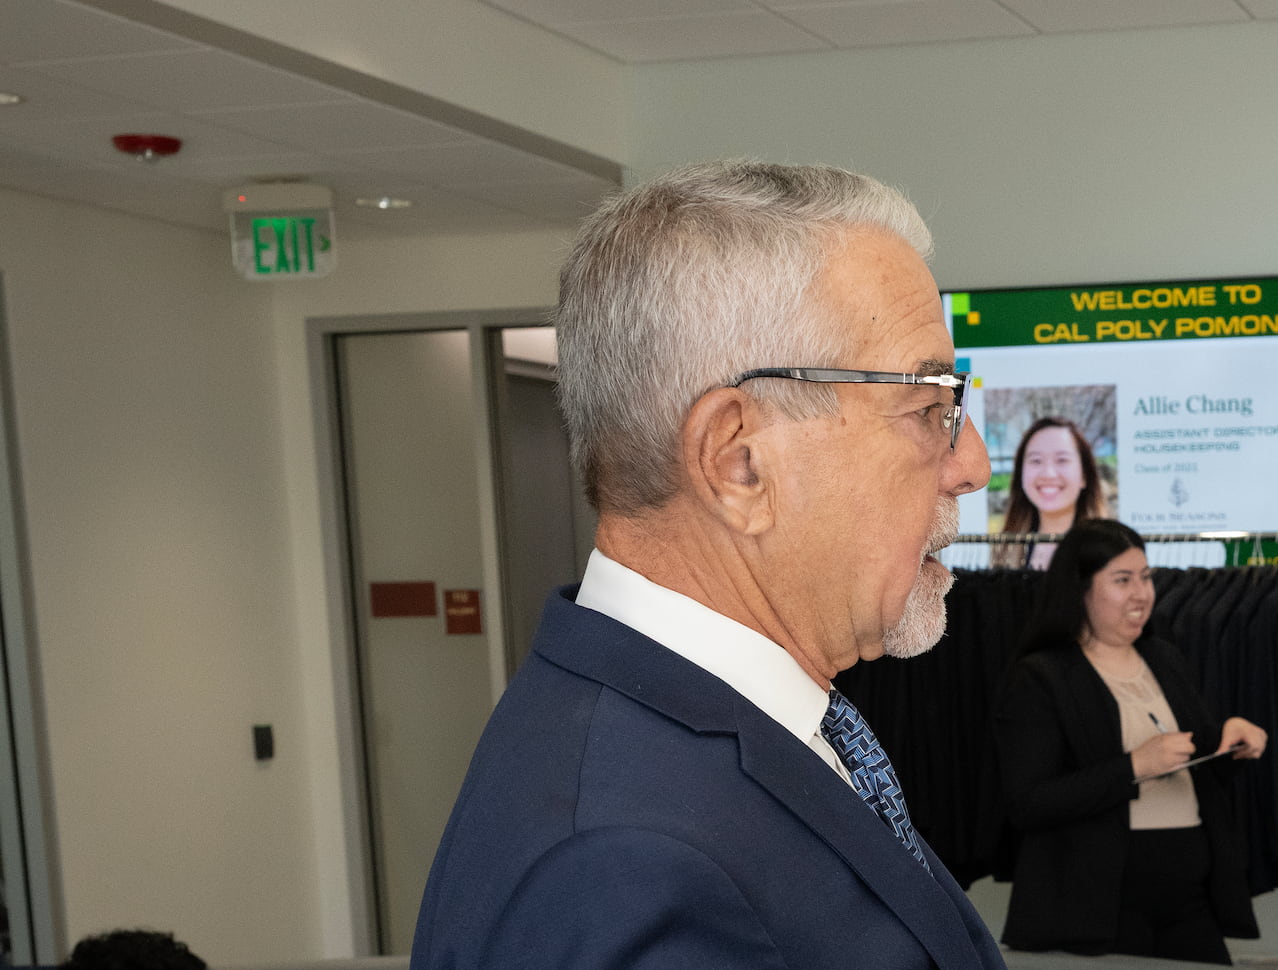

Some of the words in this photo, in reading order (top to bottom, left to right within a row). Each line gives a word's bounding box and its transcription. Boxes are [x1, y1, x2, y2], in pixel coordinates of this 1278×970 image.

[252, 217, 316, 274] EXIT
[1071, 286, 1216, 311] WELCOME
[1223, 284, 1262, 304] TO
[1033, 323, 1090, 343] CAL
[1096, 318, 1168, 340] POLY
[1133, 395, 1181, 416] Allie
[1185, 394, 1254, 416] Chang
[1134, 427, 1210, 439] ASSISTANT
[1134, 441, 1240, 454] HOUSEKEEPING
